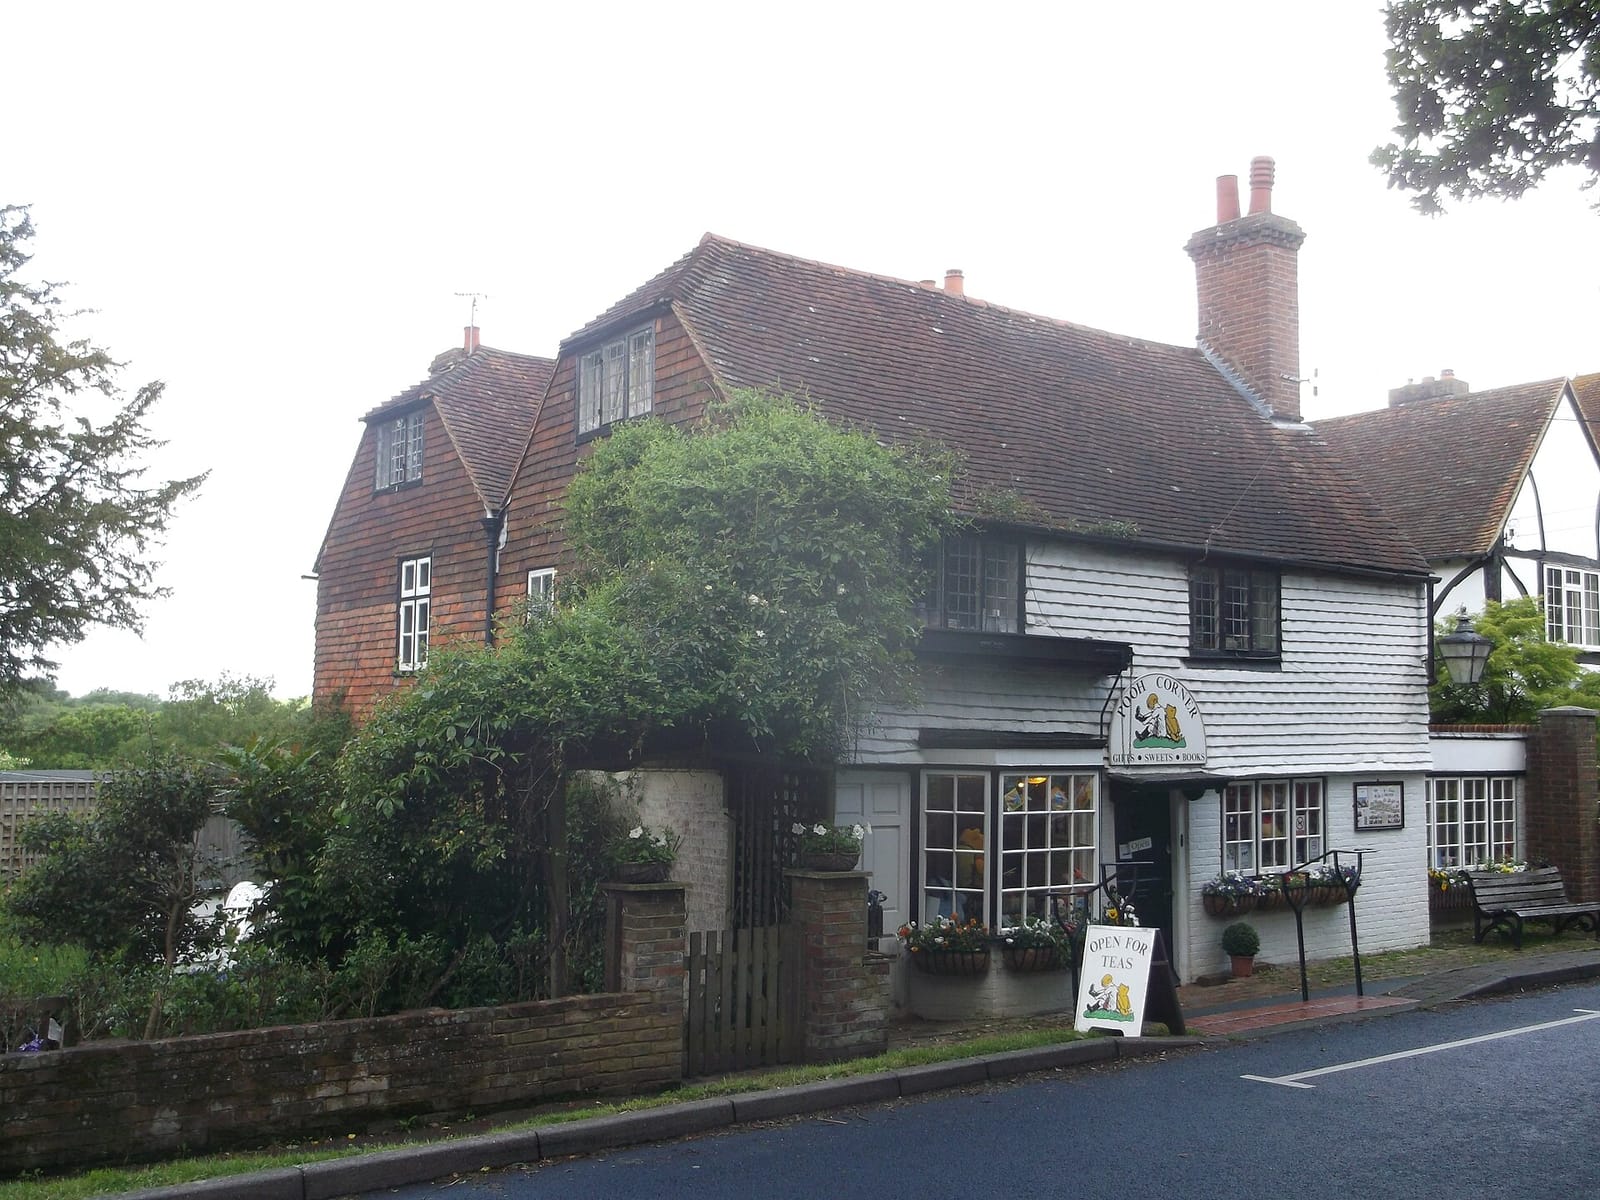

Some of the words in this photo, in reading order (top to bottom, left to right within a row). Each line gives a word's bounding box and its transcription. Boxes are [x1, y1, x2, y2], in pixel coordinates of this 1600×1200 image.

[1117, 680, 1146, 718] POOH
[1156, 676, 1198, 719] CORNER
[1112, 753, 1135, 763] GIFTS
[1144, 753, 1173, 762] SWEETS
[1182, 752, 1205, 761] BOOKS
[1089, 935, 1121, 953] OPEN
[1125, 937, 1148, 956] FOR
[1102, 955, 1133, 969] TEAS
